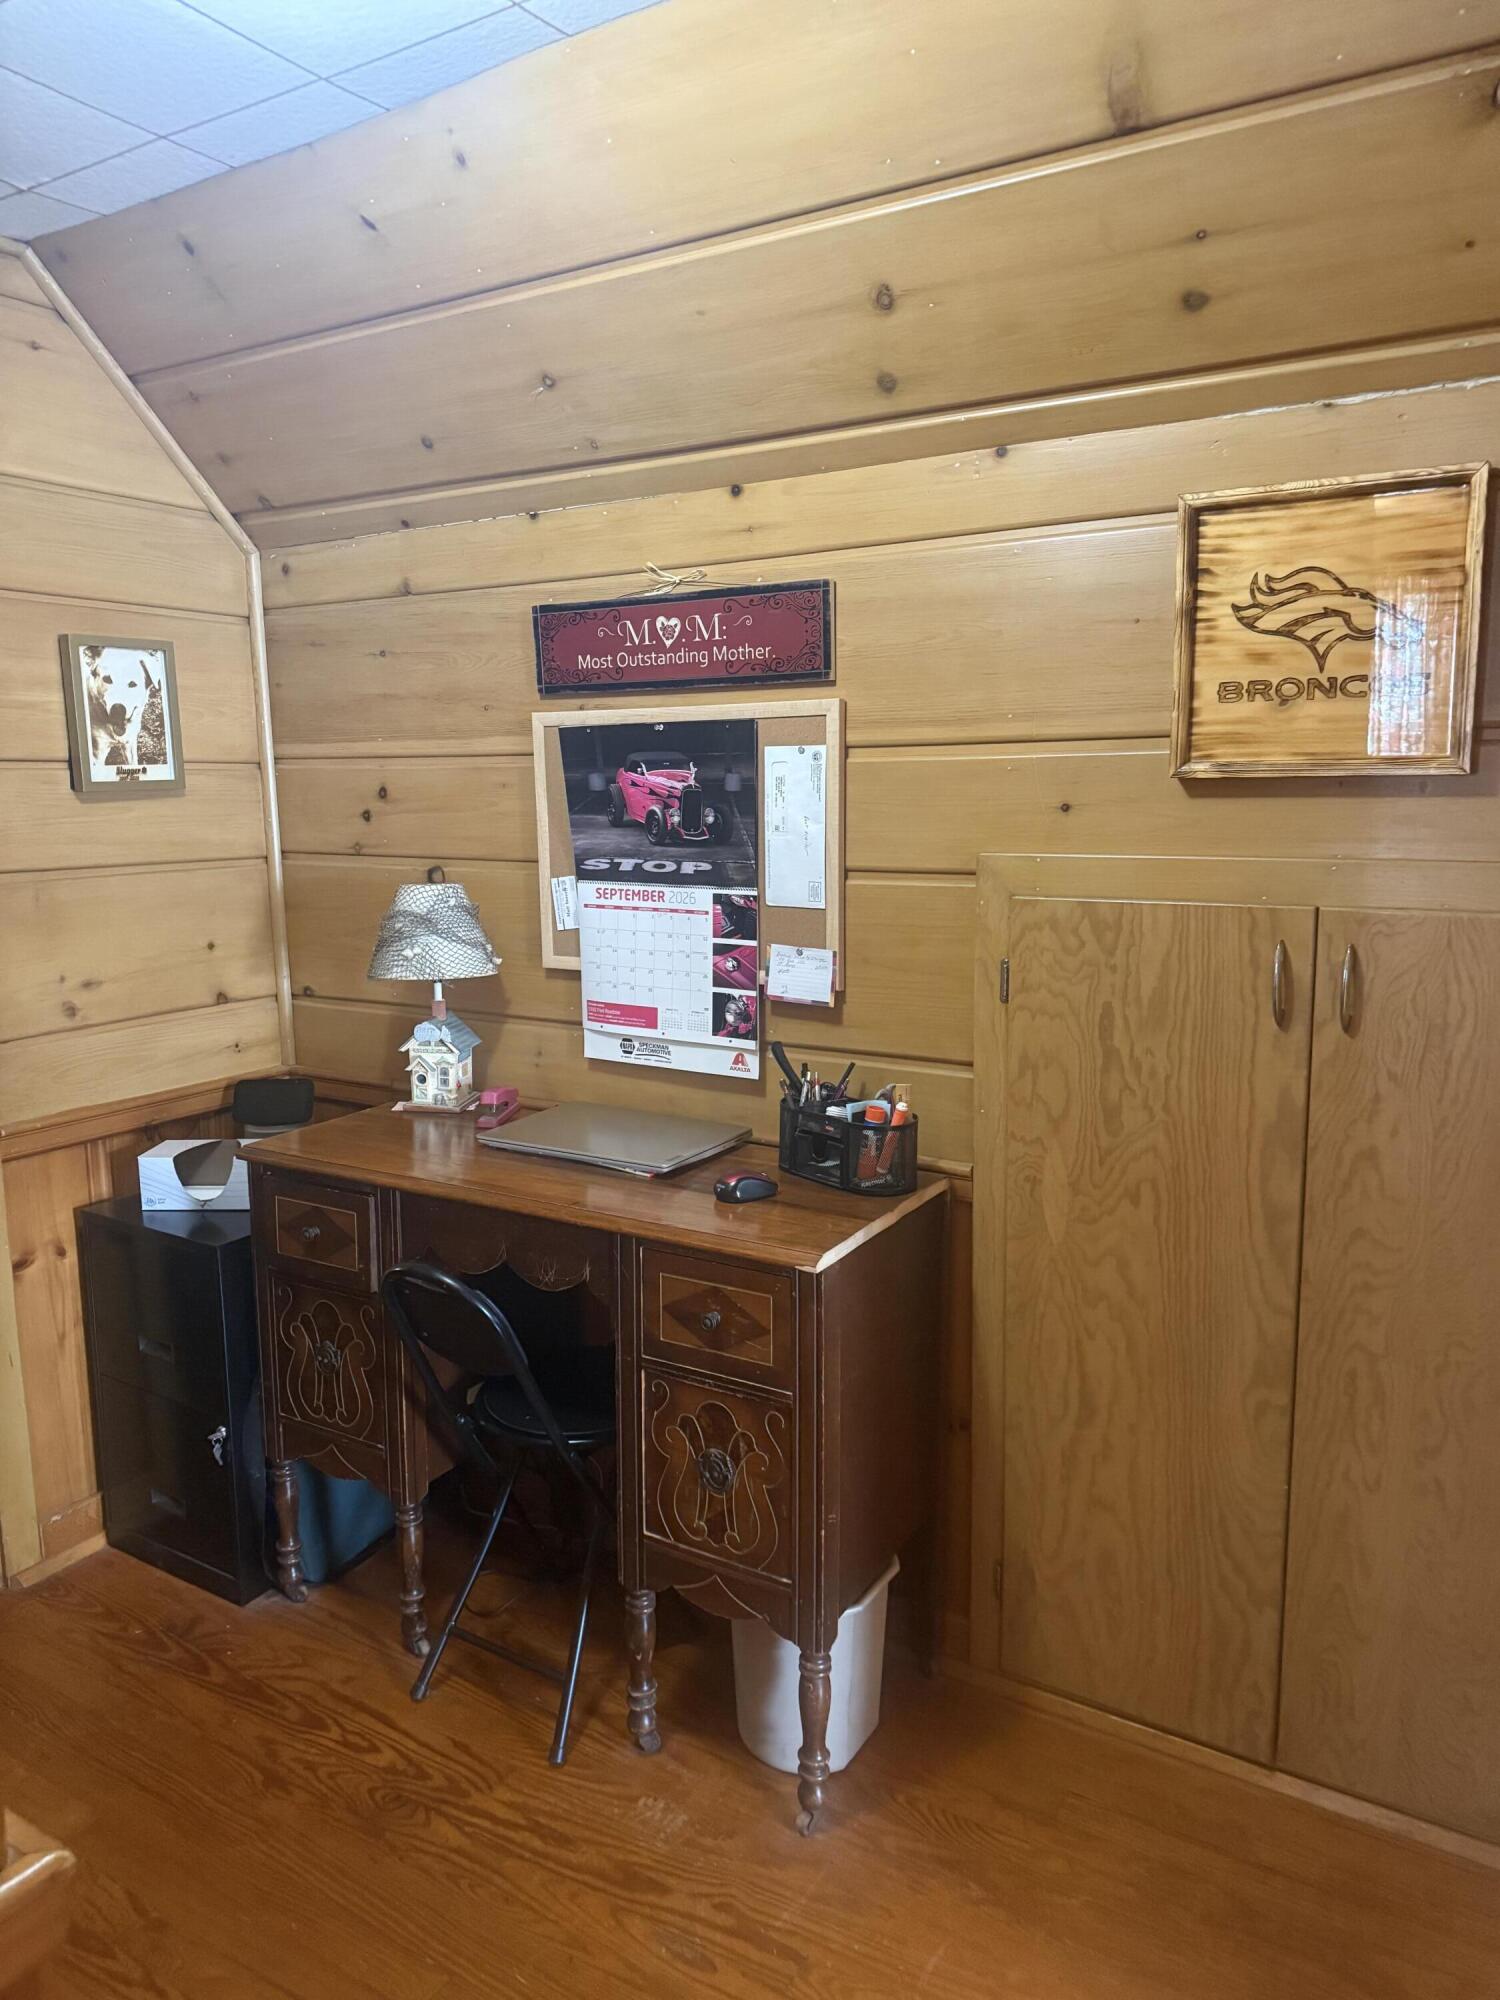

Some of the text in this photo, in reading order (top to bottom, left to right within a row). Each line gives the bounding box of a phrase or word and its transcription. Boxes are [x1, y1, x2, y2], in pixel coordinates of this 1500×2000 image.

[577, 644, 776, 670] Most Outstanding Mother.
[1217, 672, 1432, 704] BRONCS
[579, 857, 713, 875] STOP
[595, 887, 697, 905] SEPTEMBER 2026
[636, 1046, 672, 1056] AUTOMOTIVE
